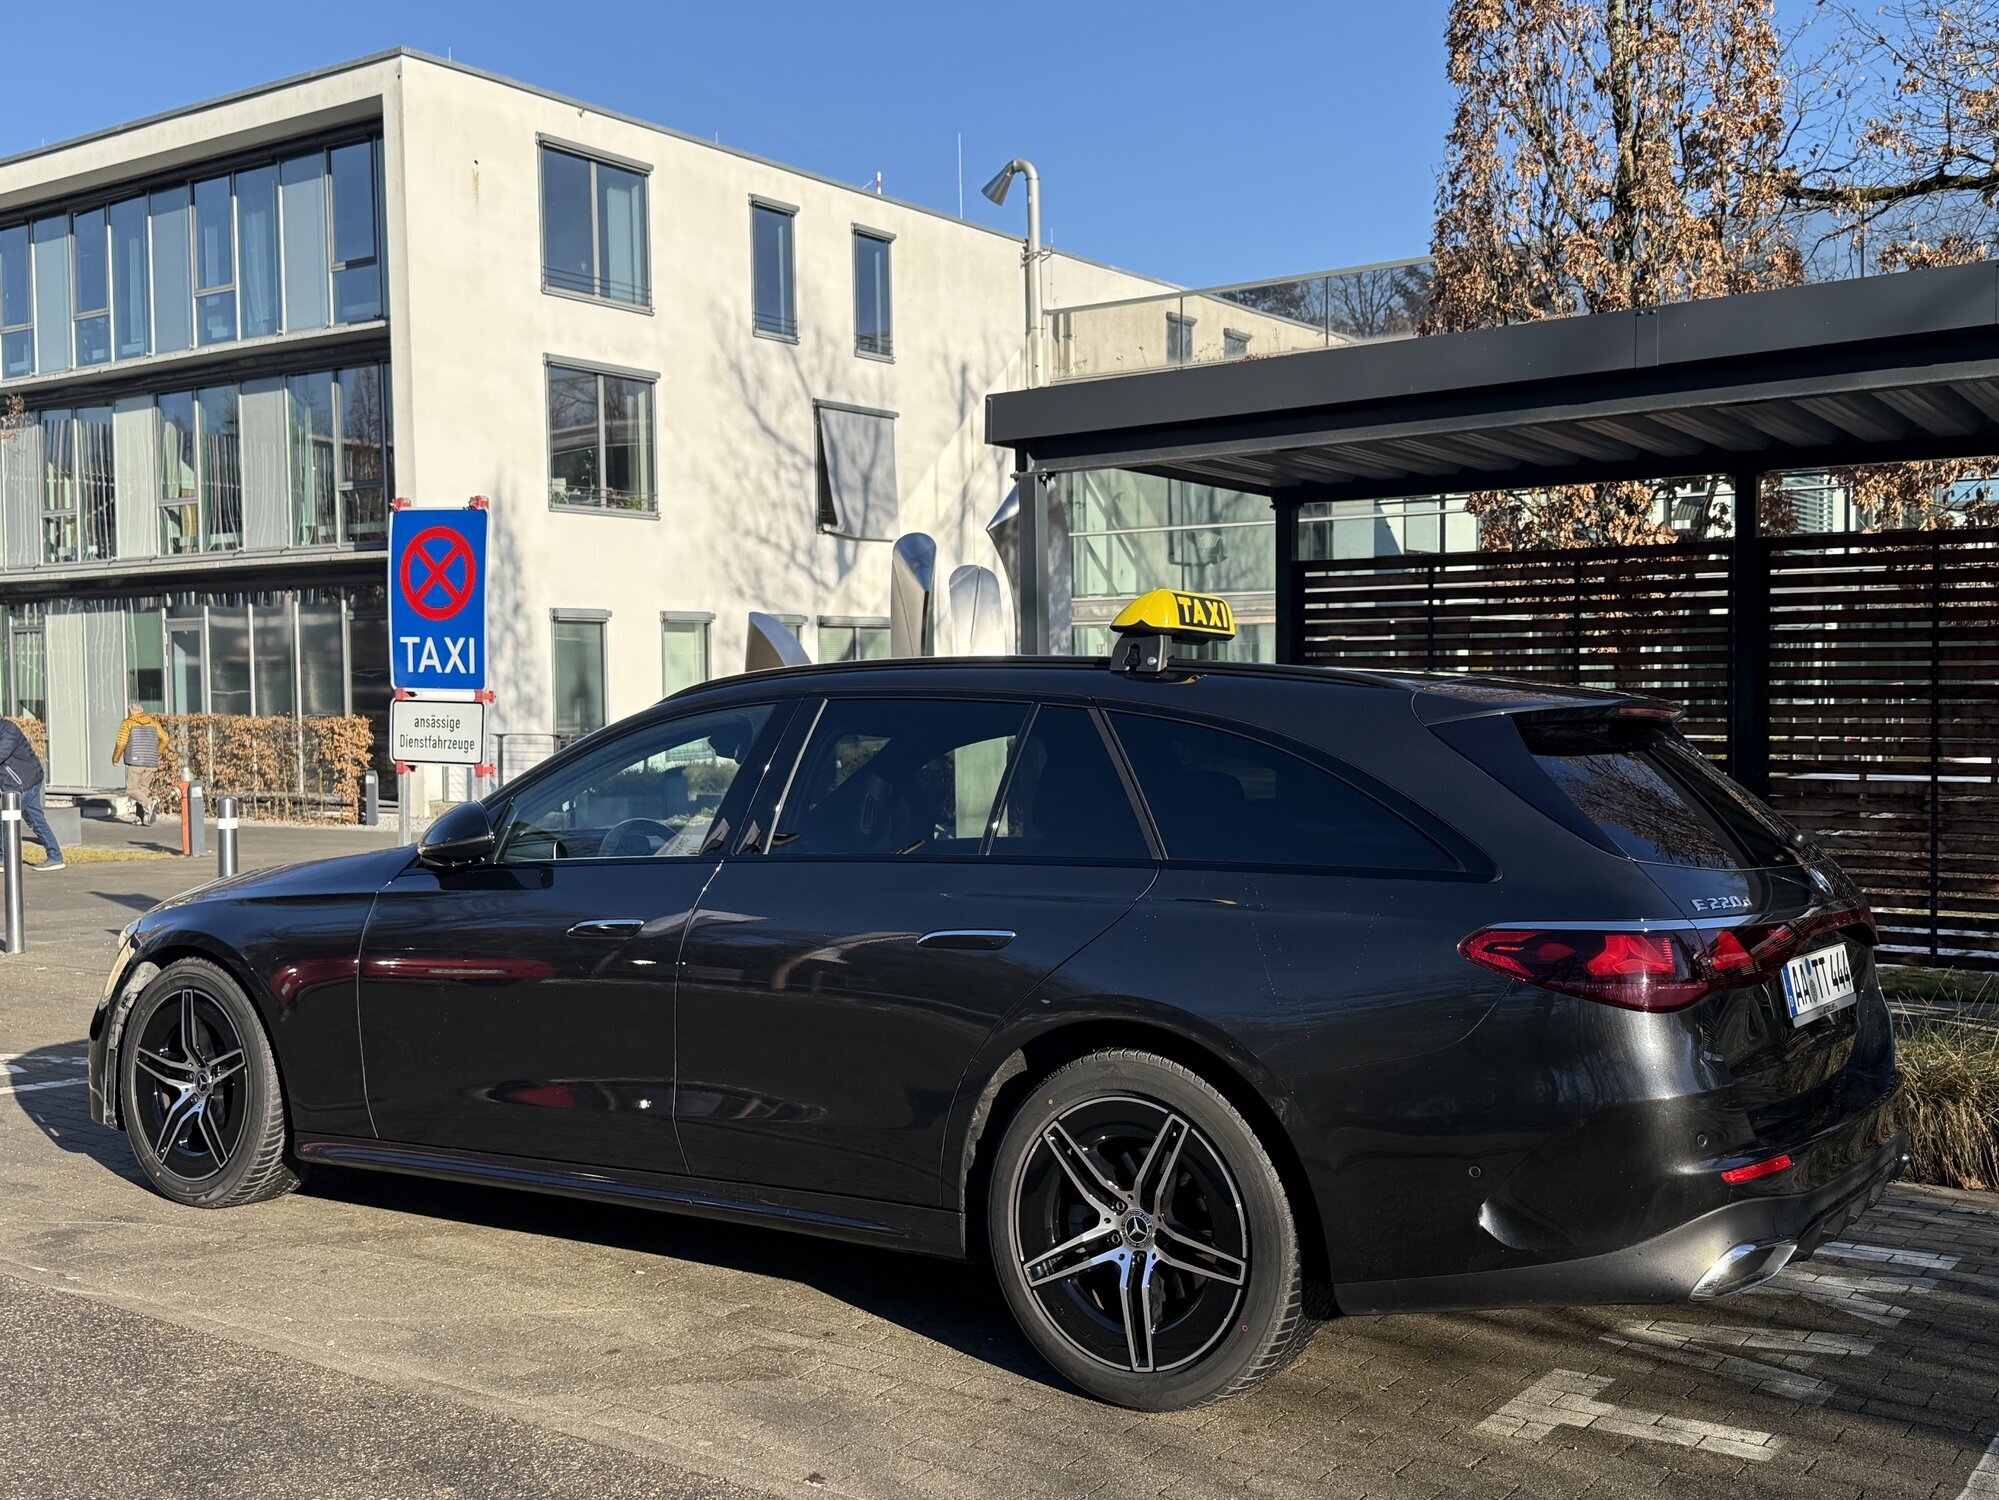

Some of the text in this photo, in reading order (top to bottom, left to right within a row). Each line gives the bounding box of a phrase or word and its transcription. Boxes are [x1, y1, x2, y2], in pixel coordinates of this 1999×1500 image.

[1177, 596, 1228, 628] TAXI
[399, 636, 476, 674] TAXI
[414, 714, 461, 732] ansässige
[399, 734, 475, 753] Dienstfahrzeuge
[1792, 963, 1812, 1008] AA
[1830, 950, 1852, 992] 444
